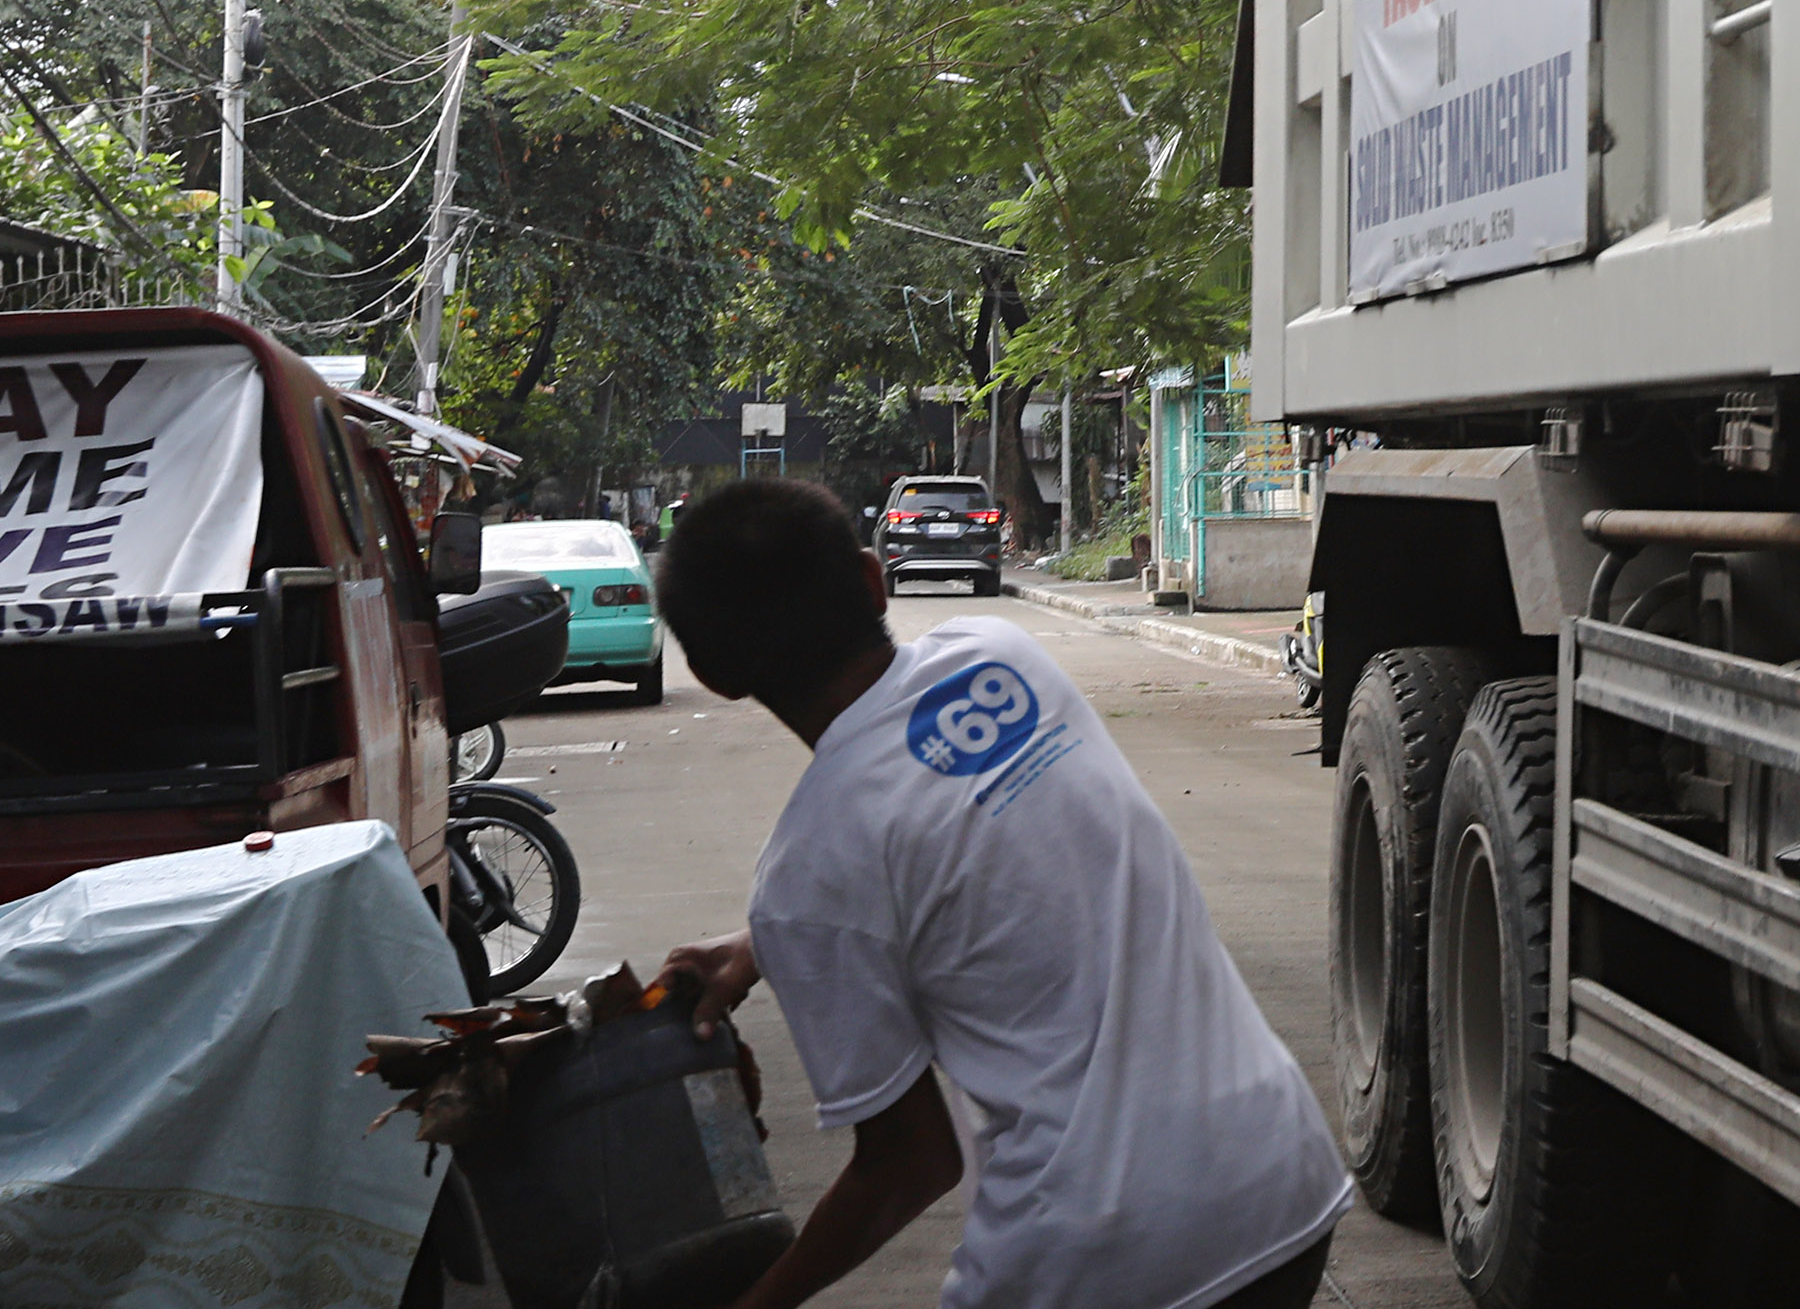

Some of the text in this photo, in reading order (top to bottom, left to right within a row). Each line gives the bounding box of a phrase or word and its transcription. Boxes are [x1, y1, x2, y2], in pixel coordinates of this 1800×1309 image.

[1437, 9, 1457, 89] ON
[1394, 104, 1443, 221] WASTE
[1446, 50, 1572, 205] MANAGEMENT
[921, 665, 1031, 772] #69
